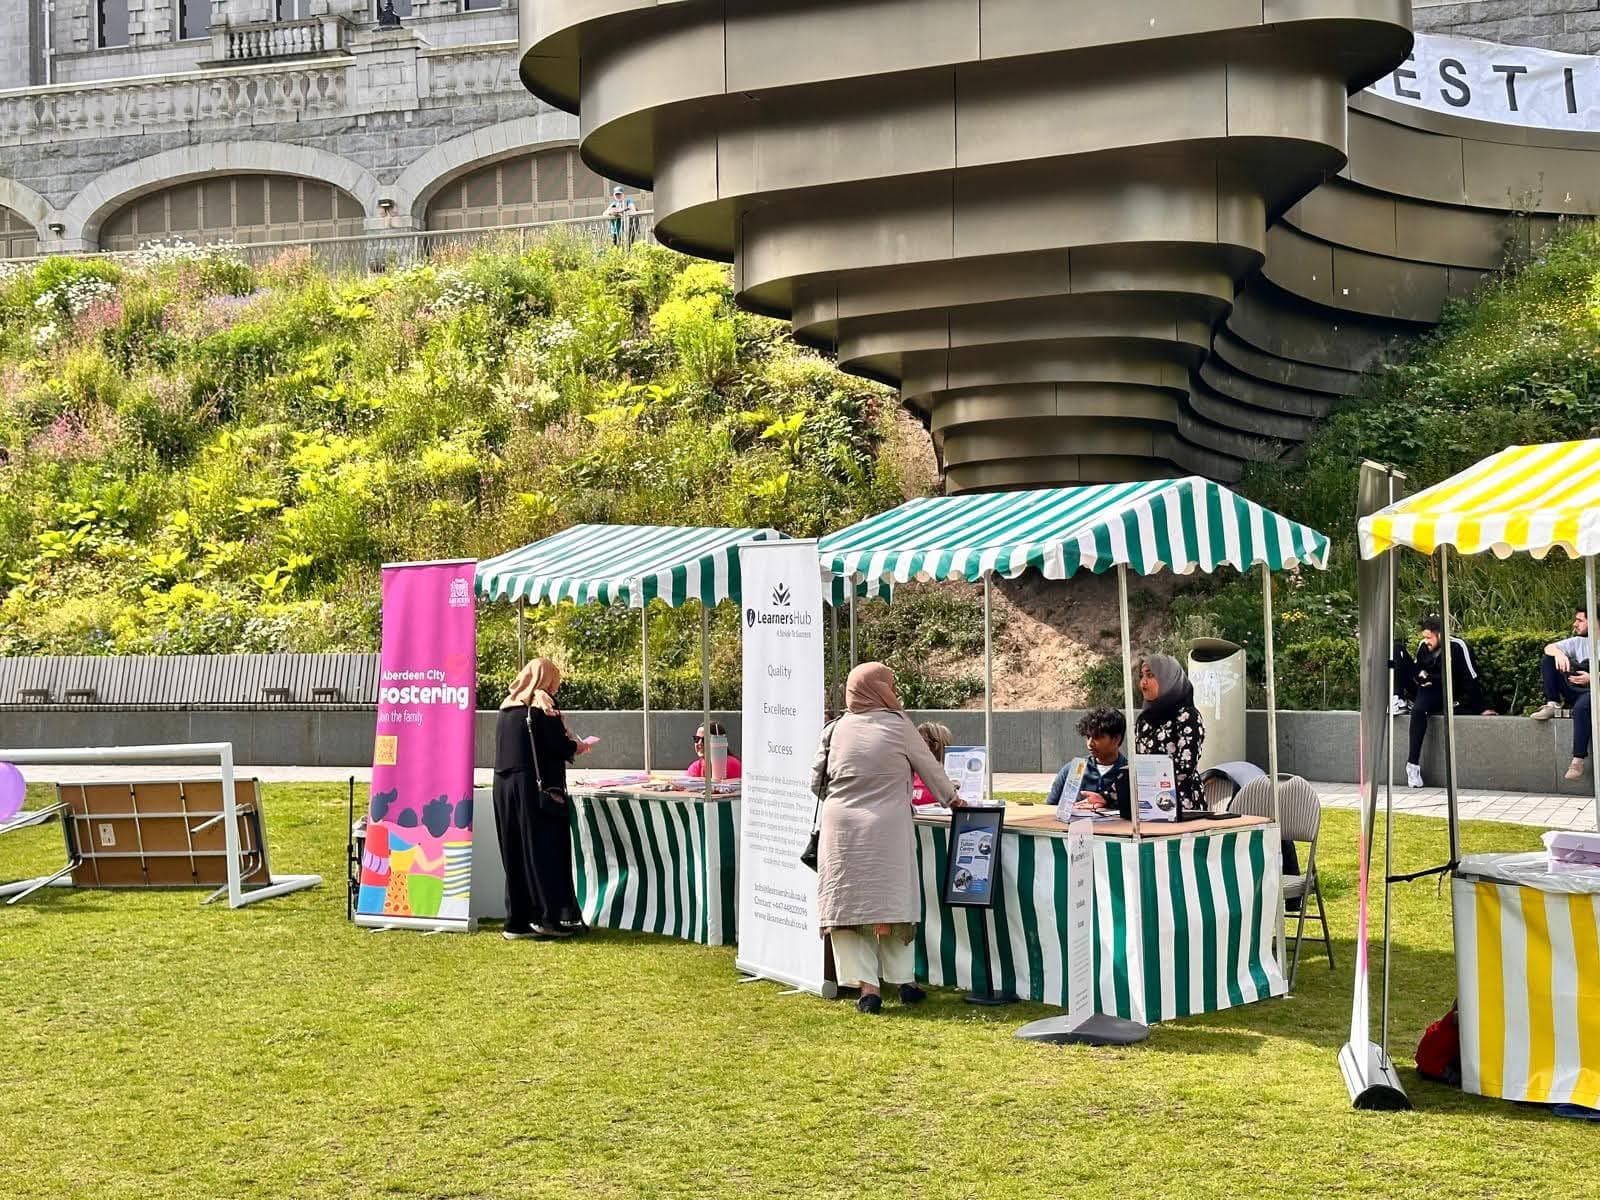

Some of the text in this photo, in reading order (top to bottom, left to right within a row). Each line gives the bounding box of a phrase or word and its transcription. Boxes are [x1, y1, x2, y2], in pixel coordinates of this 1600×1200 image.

[1370, 52, 1578, 114] ESTI
[382, 669, 446, 682] Aberdeen City
[767, 664, 792, 680] Quality
[380, 683, 469, 710] Fostering
[390, 709, 402, 722] the
[763, 702, 797, 716] Excellence
[767, 740, 793, 756] Success
